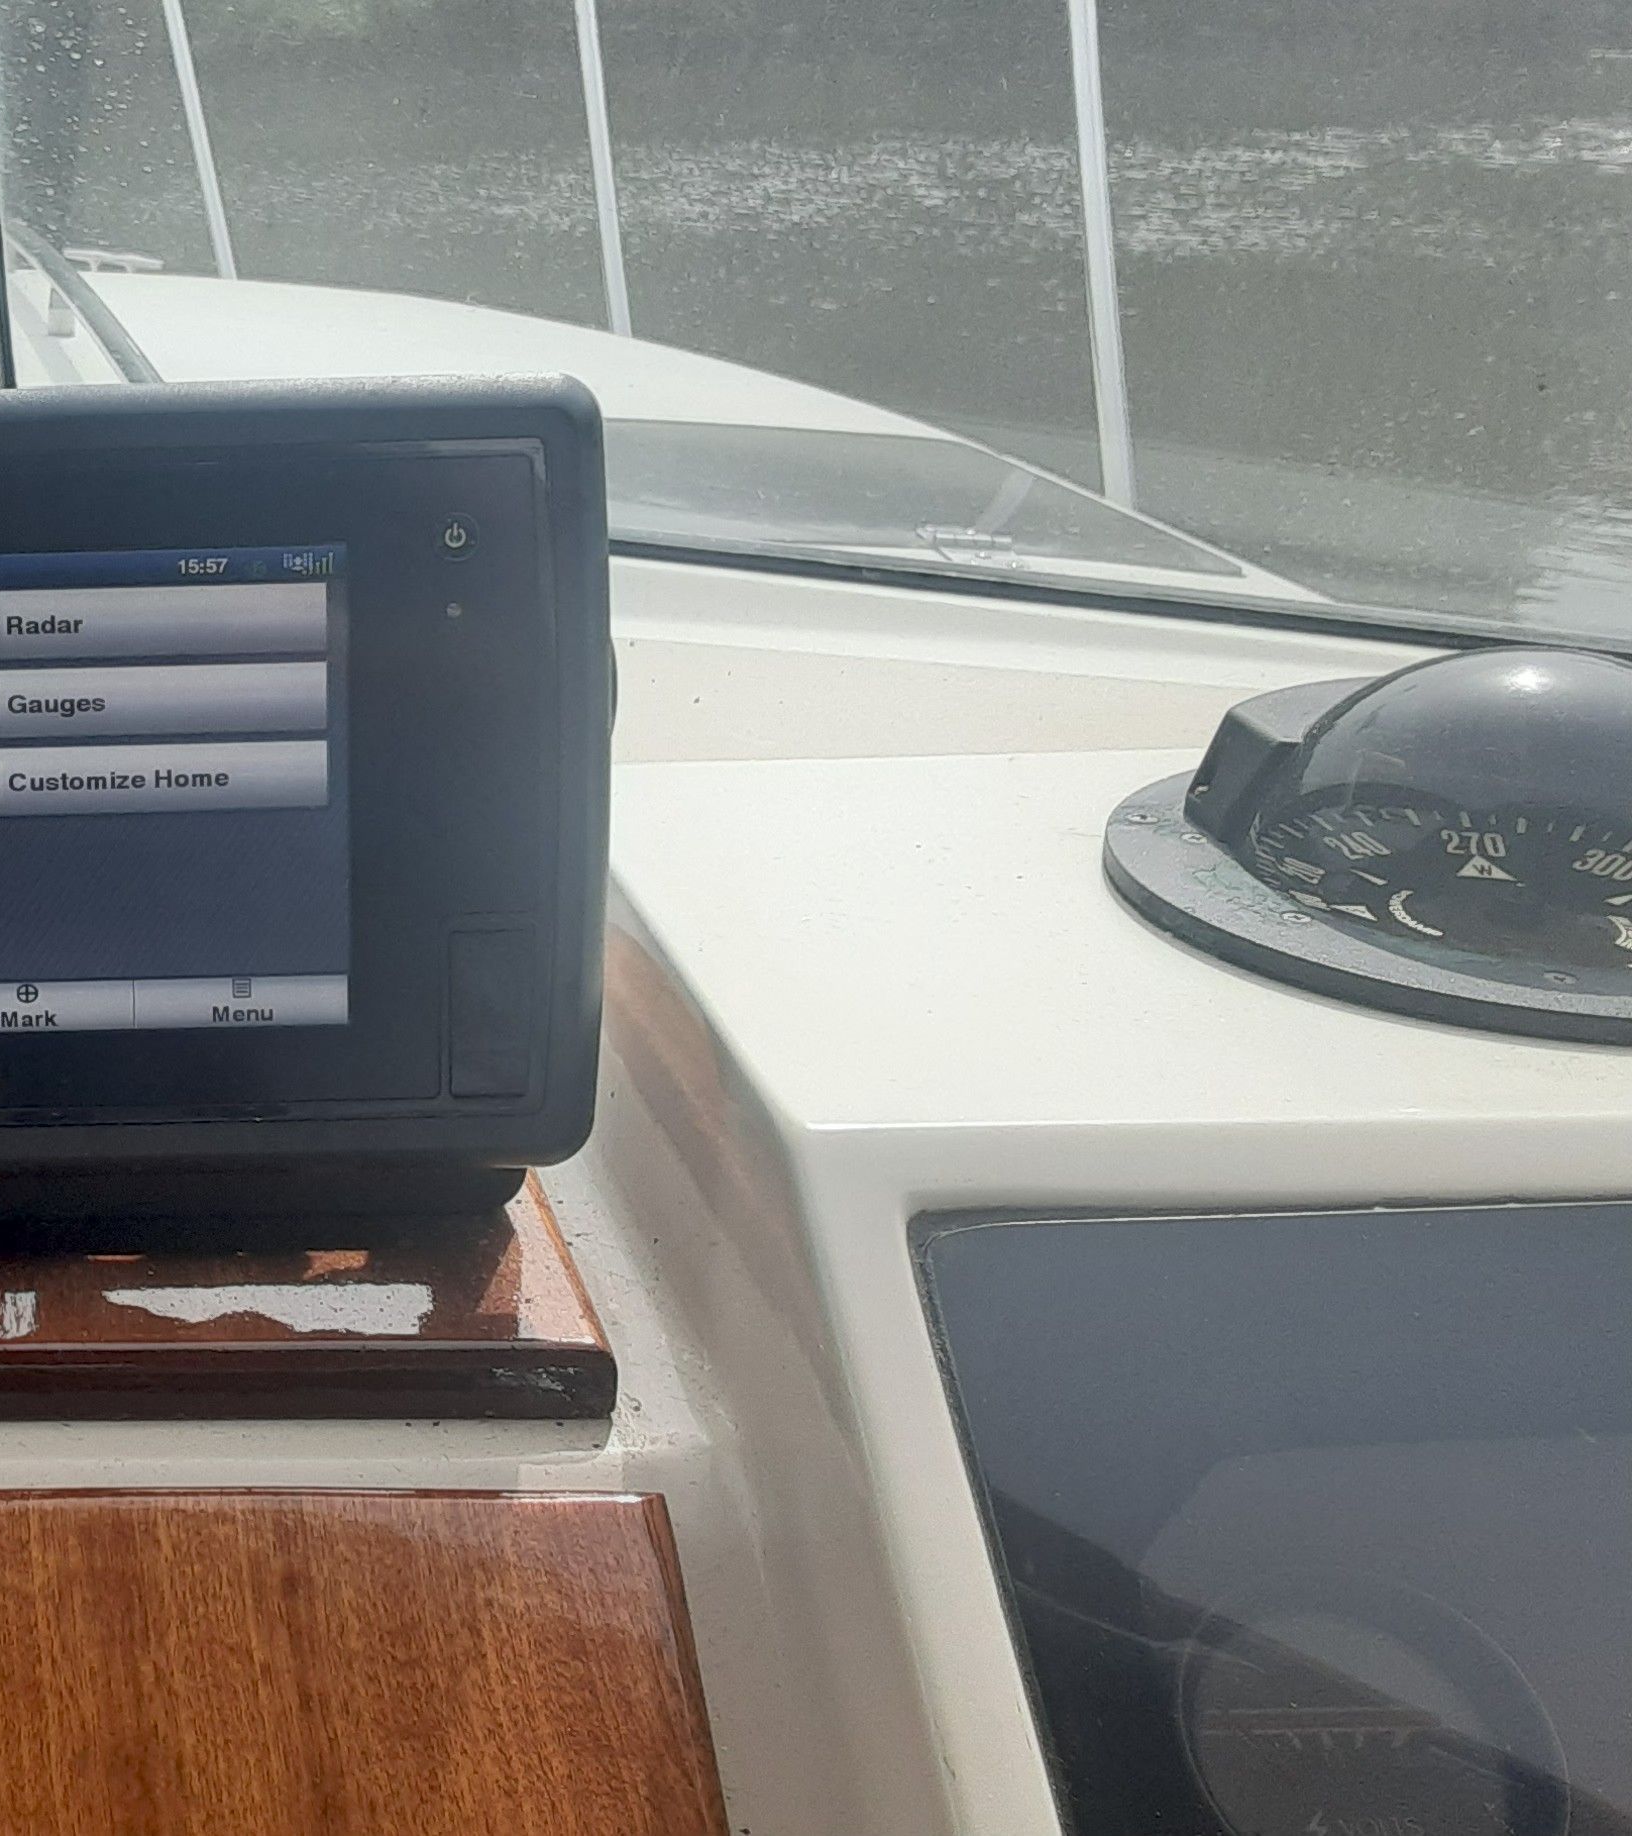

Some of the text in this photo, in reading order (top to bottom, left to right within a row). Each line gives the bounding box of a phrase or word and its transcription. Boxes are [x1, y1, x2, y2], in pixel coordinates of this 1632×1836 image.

[177, 558, 228, 574] 15:57
[6, 614, 84, 635] Radar
[7, 694, 106, 717] Gauges
[8, 769, 230, 794] Customize Home
[1323, 831, 1392, 860] 240
[1440, 829, 1507, 857] 270
[1474, 863, 1494, 876] W
[0, 1010, 58, 1029] Mark
[212, 1005, 274, 1023] Menu
